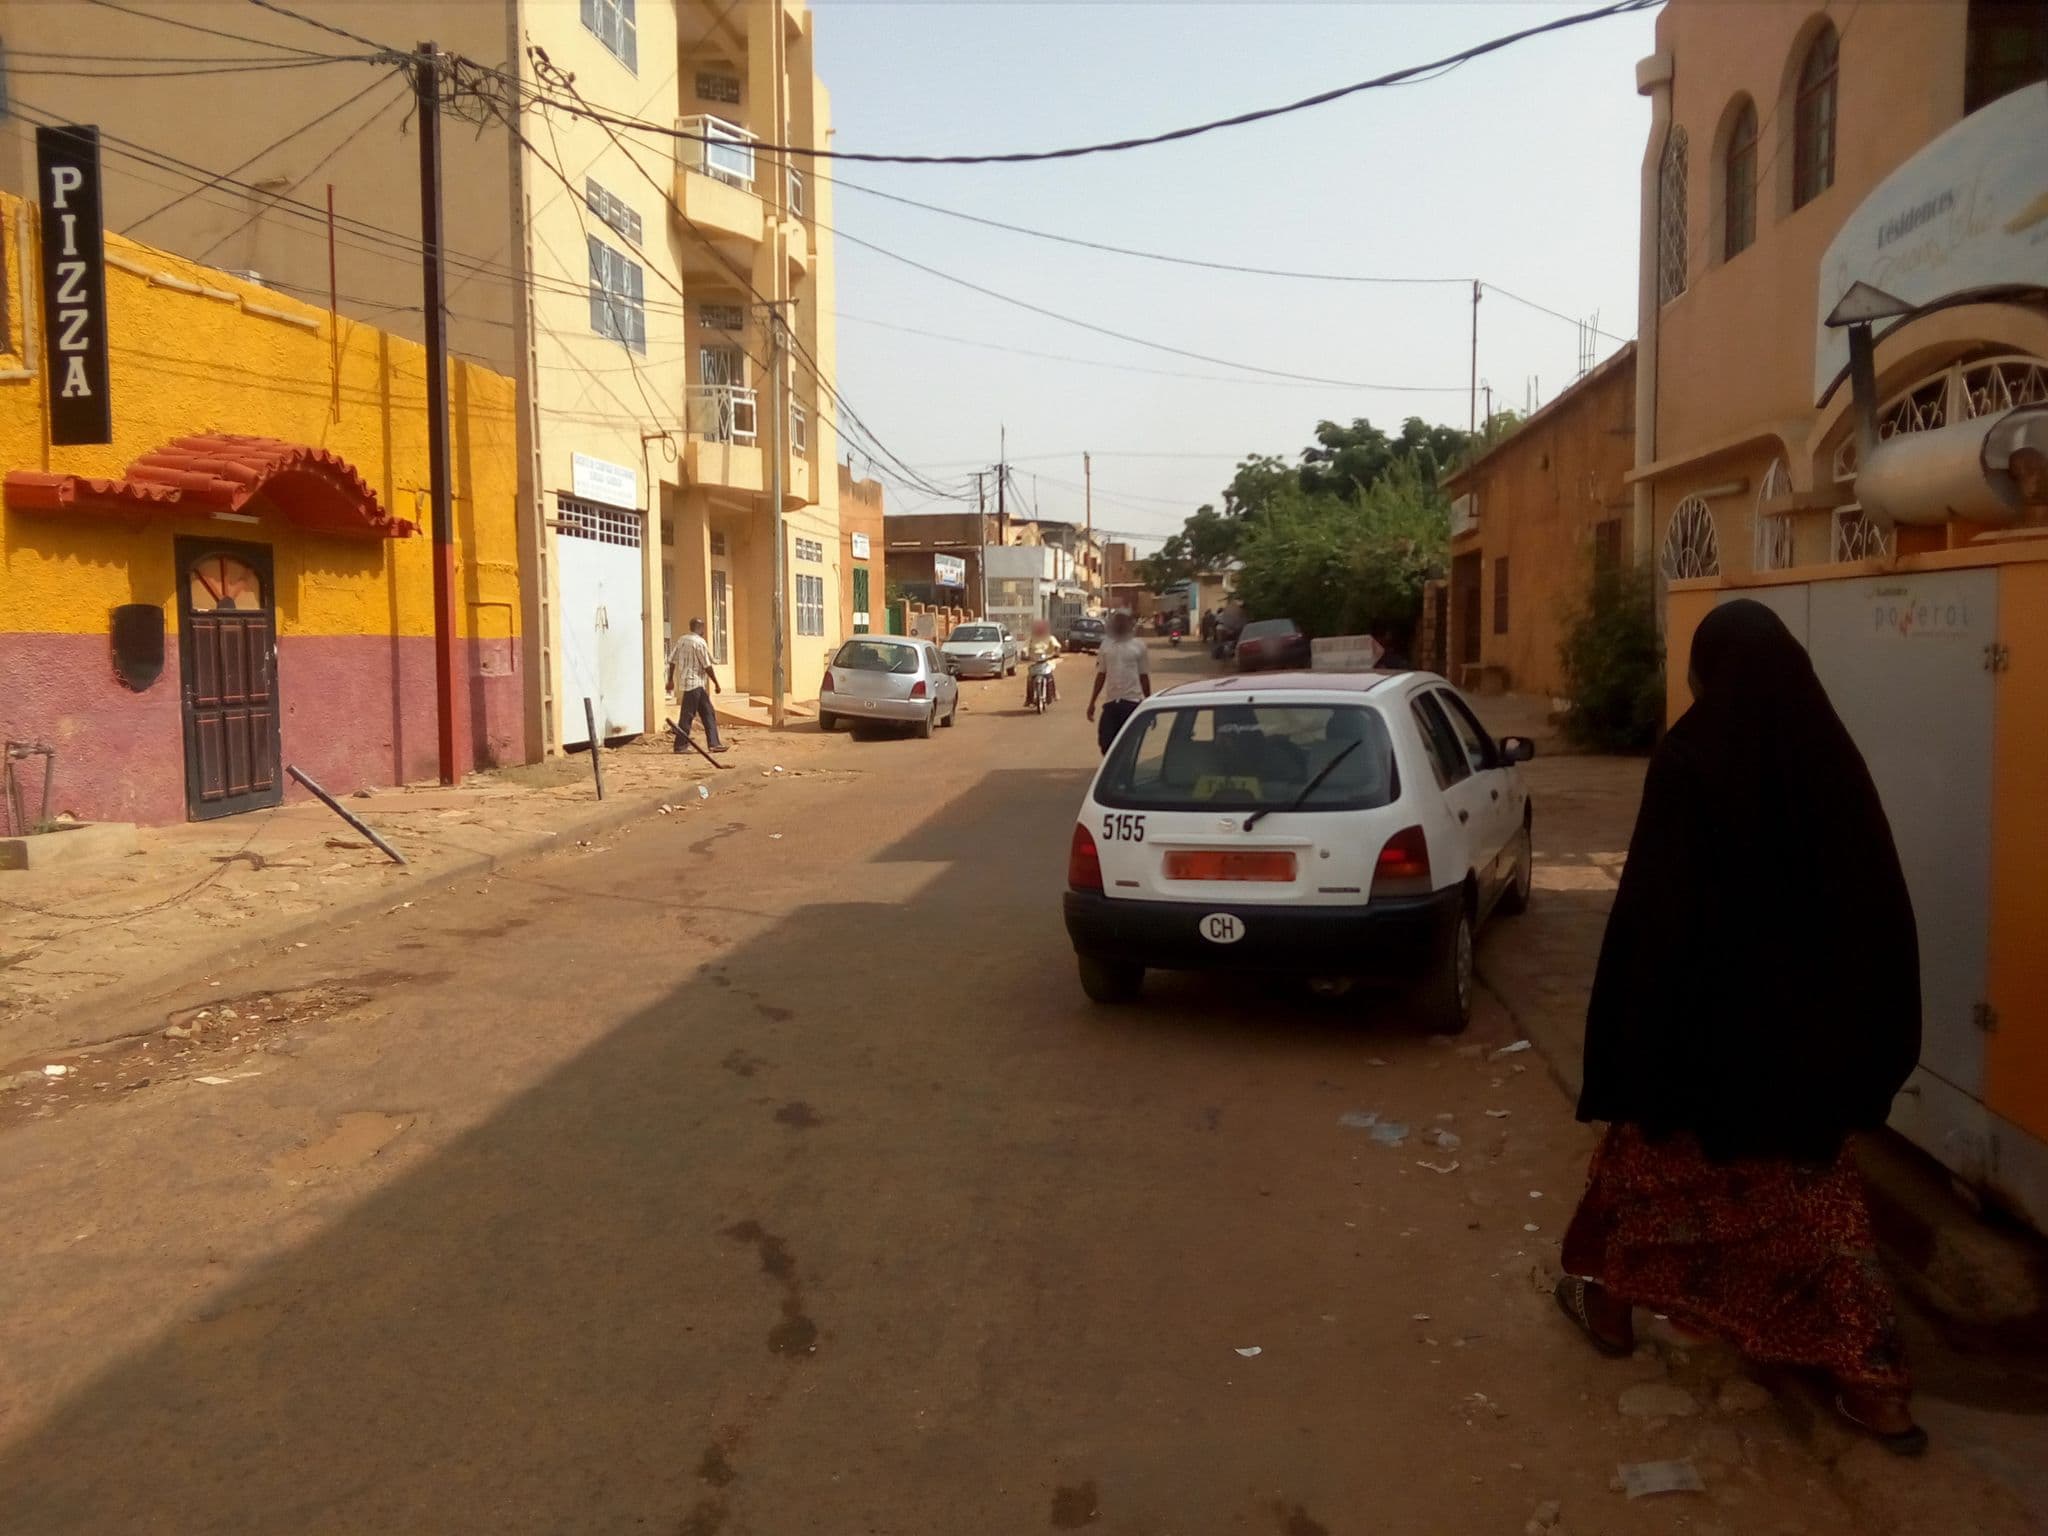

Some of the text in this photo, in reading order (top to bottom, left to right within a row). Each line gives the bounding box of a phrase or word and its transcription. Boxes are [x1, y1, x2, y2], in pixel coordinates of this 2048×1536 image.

[51, 166, 92, 397] PIZZA
[1102, 813, 1146, 842] 5155
[1209, 917, 1234, 939] CH
